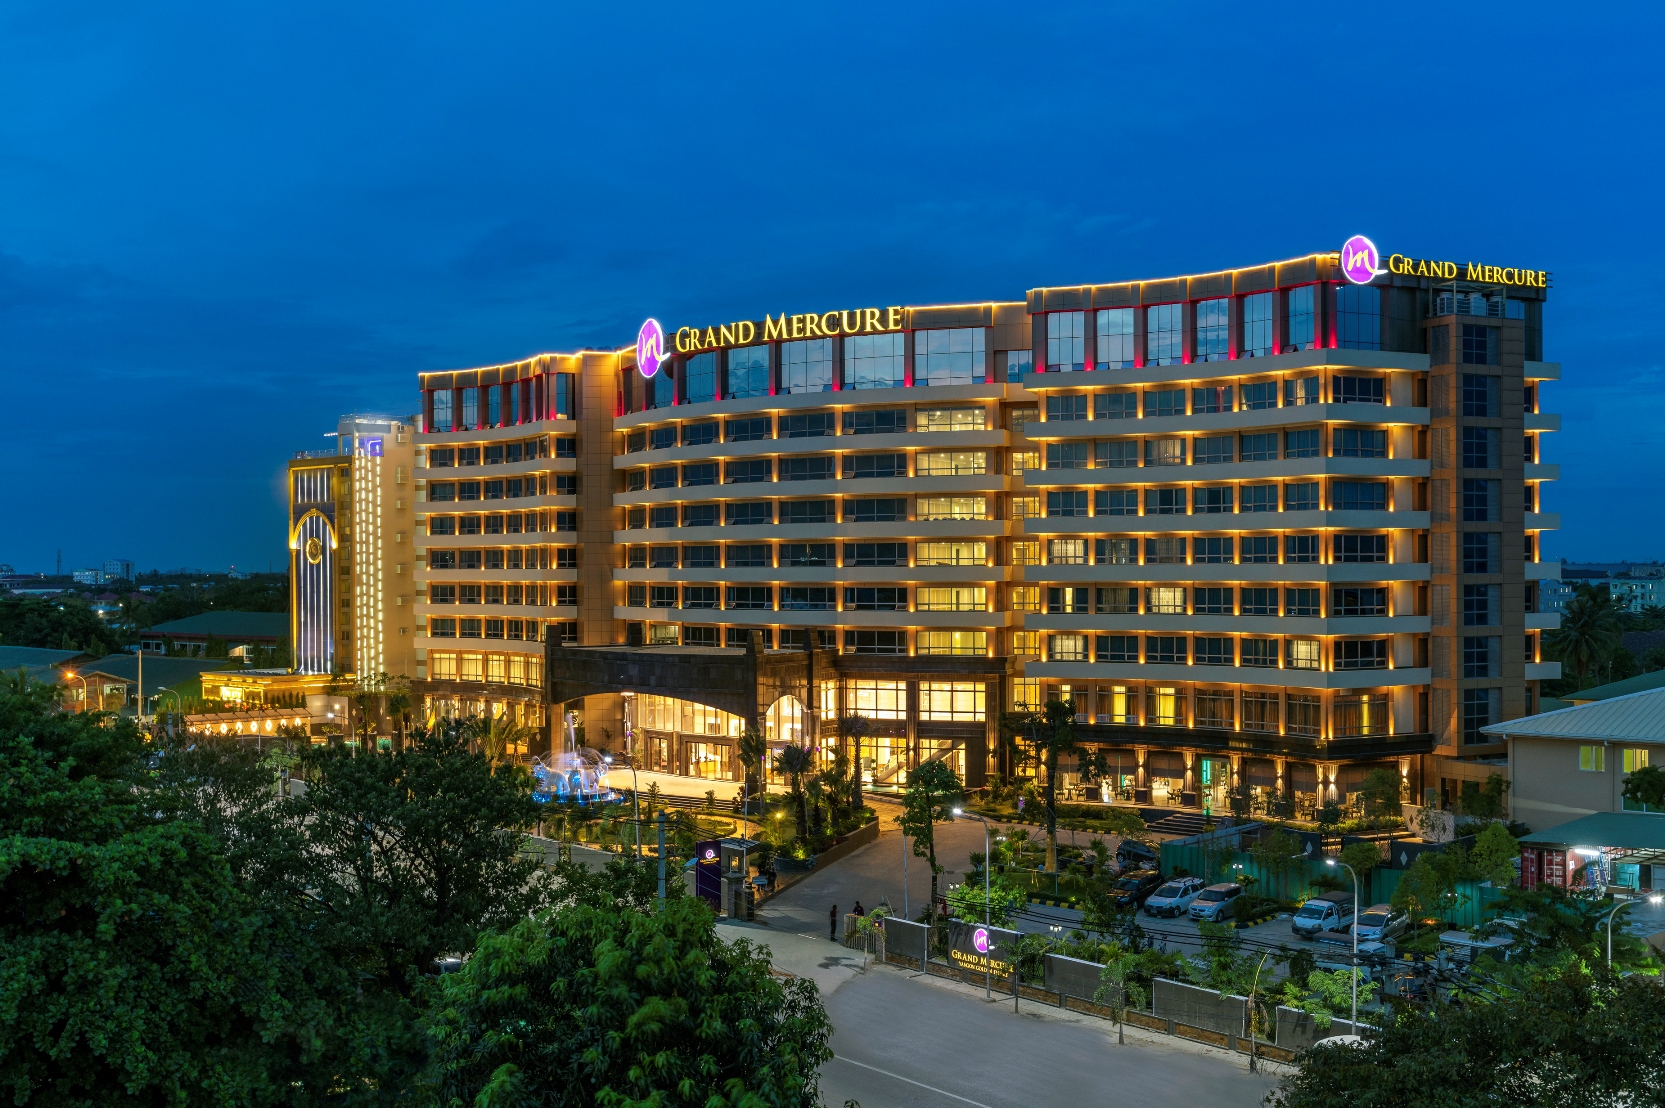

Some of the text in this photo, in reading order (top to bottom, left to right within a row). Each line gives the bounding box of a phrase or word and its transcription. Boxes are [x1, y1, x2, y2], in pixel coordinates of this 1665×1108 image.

[1389, 253, 1547, 288] GRAND MERCURE
[675, 306, 902, 354] GRAND MERCURE
[951, 949, 979, 964] GRAND
